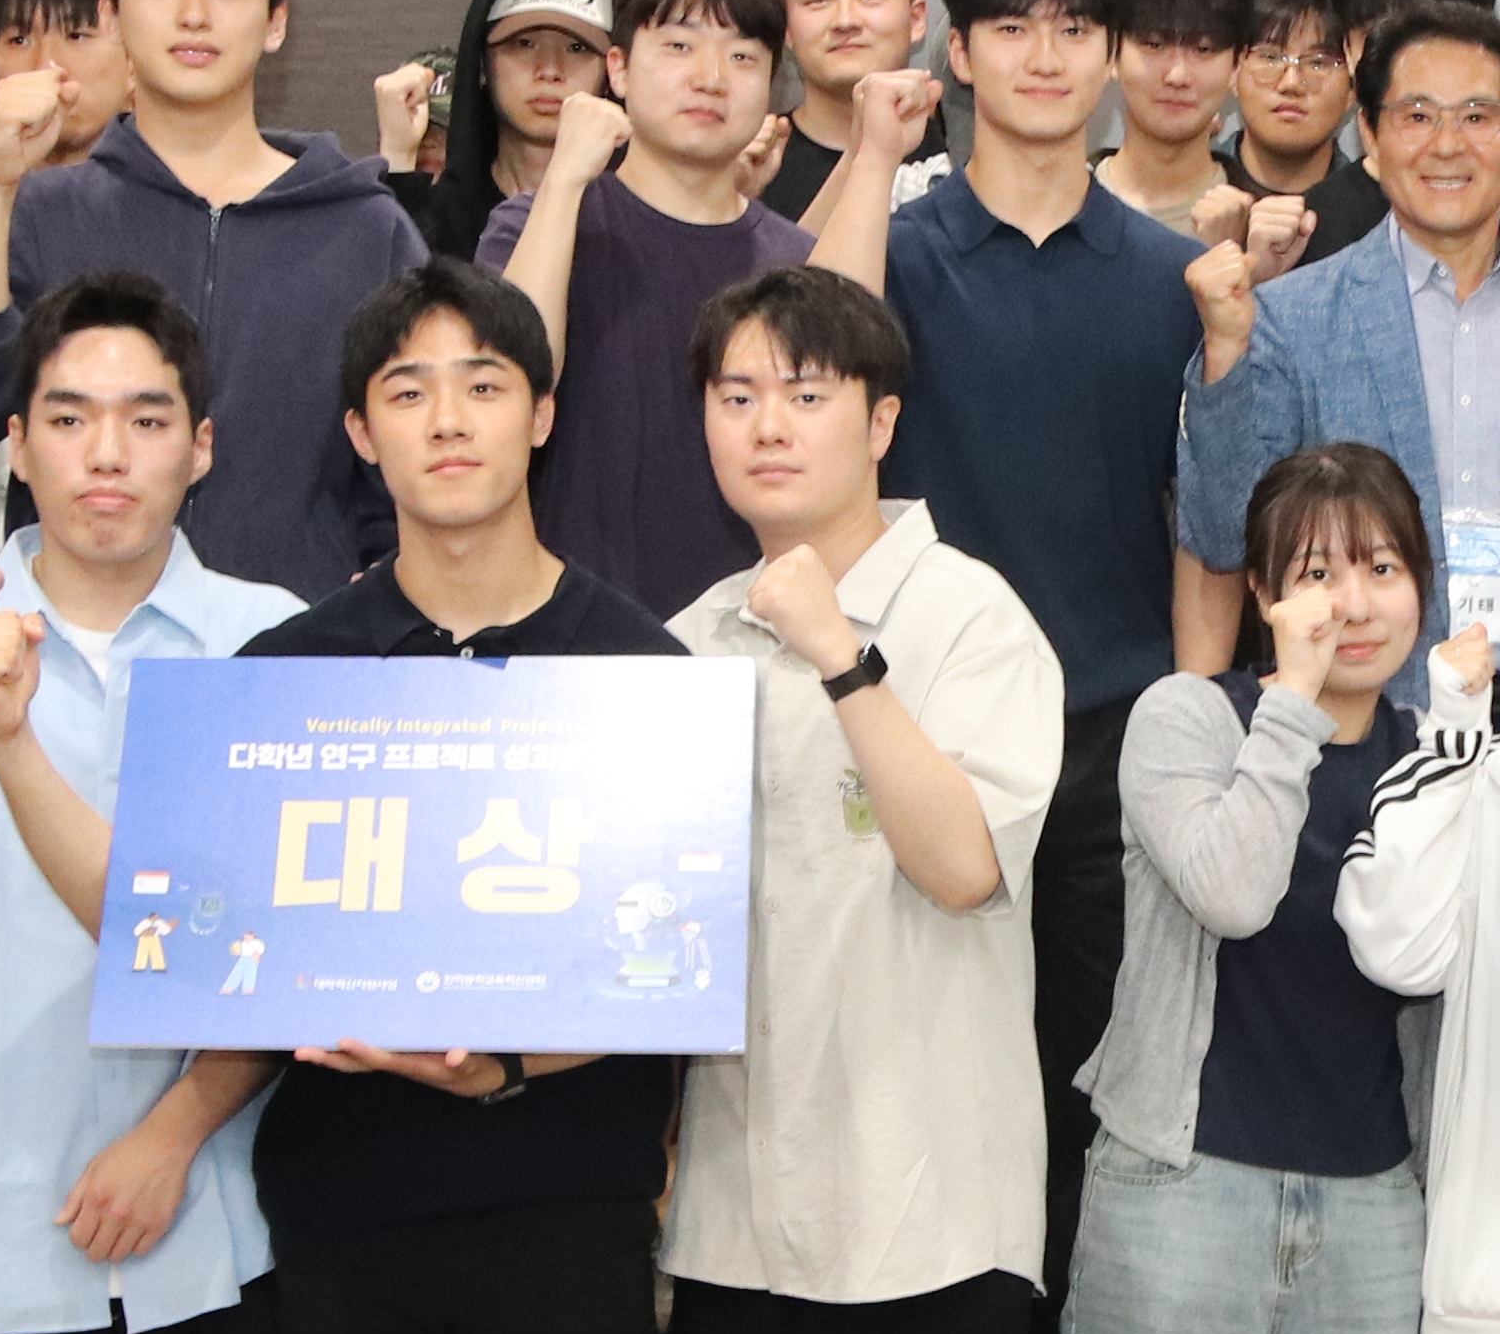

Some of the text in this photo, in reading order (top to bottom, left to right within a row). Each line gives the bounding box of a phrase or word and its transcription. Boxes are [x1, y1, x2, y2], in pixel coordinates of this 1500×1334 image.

[306, 716, 391, 737] Vertically
[396, 716, 491, 737] Integrated
[229, 743, 314, 770] 다학년
[320, 743, 376, 770] 연구
[383, 743, 496, 771] 프로젝트
[273, 796, 595, 914] 대 상
